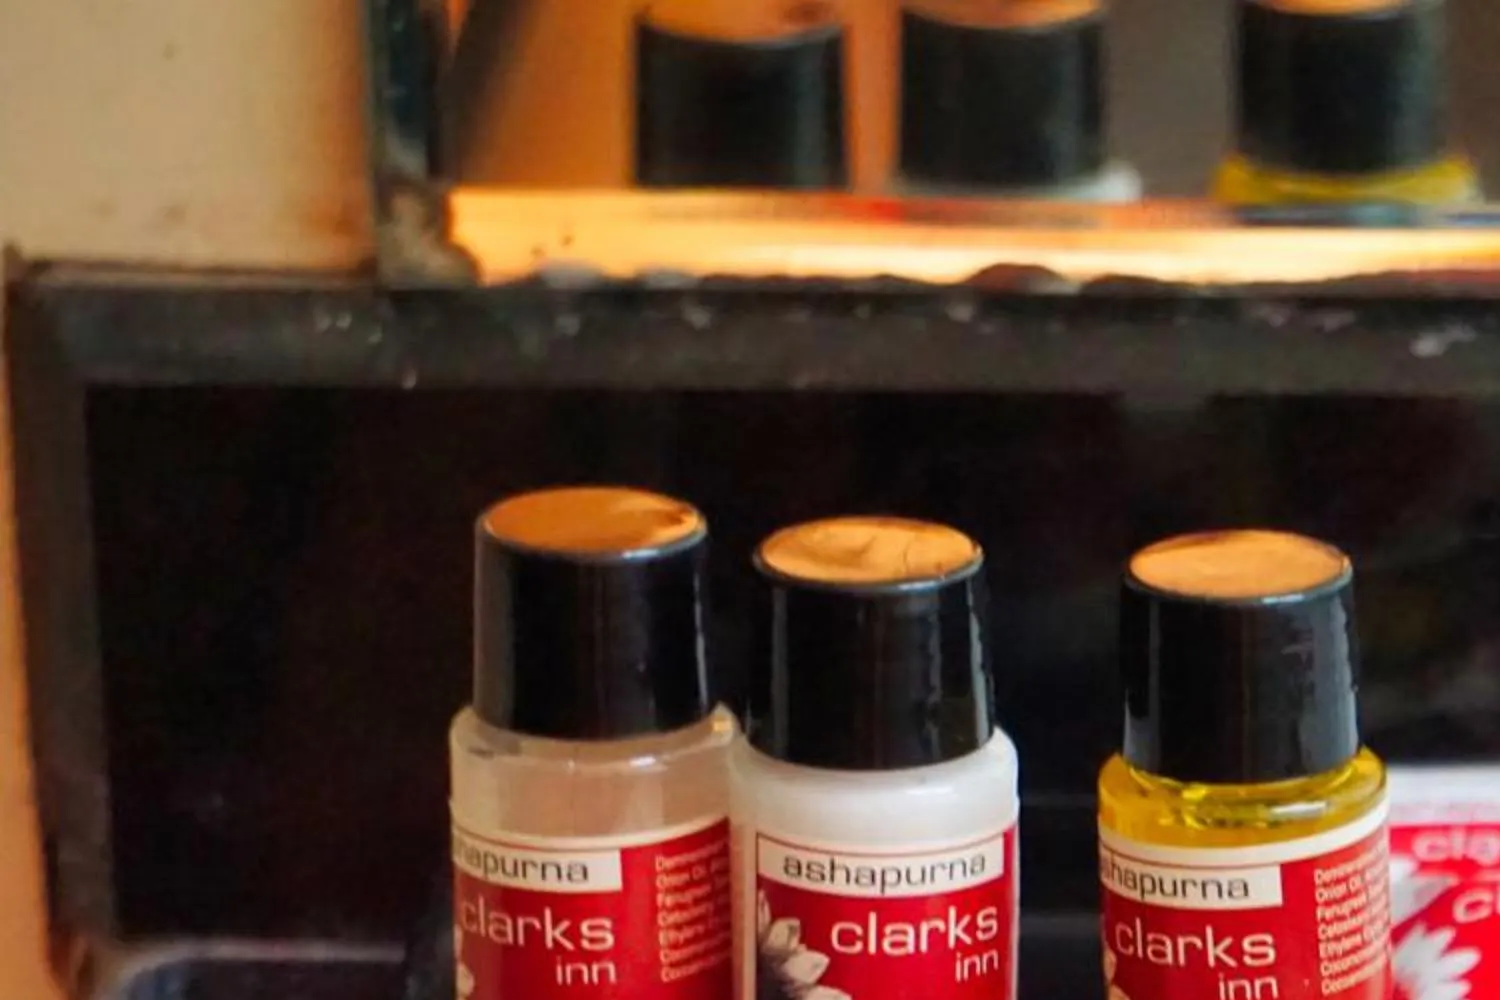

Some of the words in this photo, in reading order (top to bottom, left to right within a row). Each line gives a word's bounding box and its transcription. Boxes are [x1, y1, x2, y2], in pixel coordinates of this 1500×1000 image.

[783, 853, 986, 895] ashapurna
[462, 895, 615, 951] clarks
[831, 905, 998, 956] clarks
[1115, 917, 1276, 968] clarks
[556, 954, 617, 986] inn
[955, 949, 999, 983] inn
